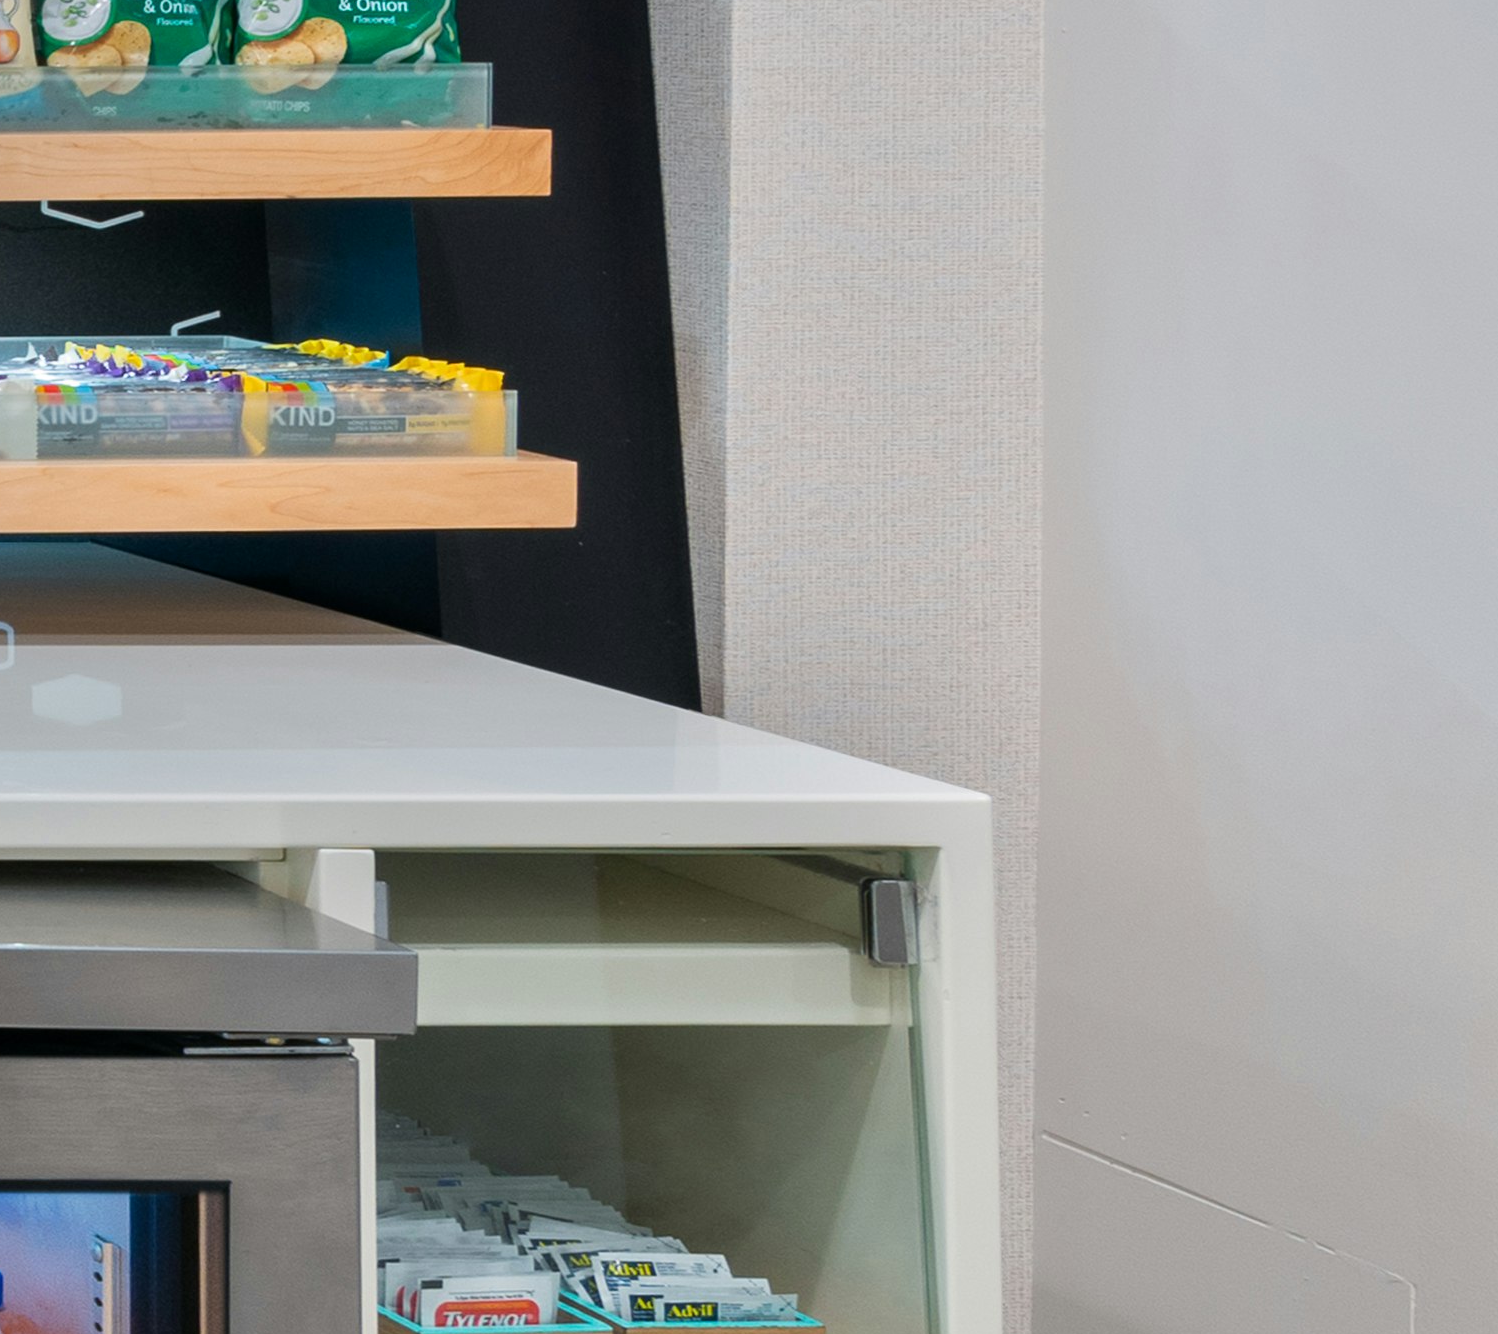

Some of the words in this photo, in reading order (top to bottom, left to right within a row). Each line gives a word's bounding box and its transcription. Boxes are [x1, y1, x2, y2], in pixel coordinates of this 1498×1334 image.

[39, 404, 97, 425] KIND
[269, 406, 335, 427] KIND
[606, 1261, 651, 1278] Advil
[668, 1303, 714, 1320] Advil
